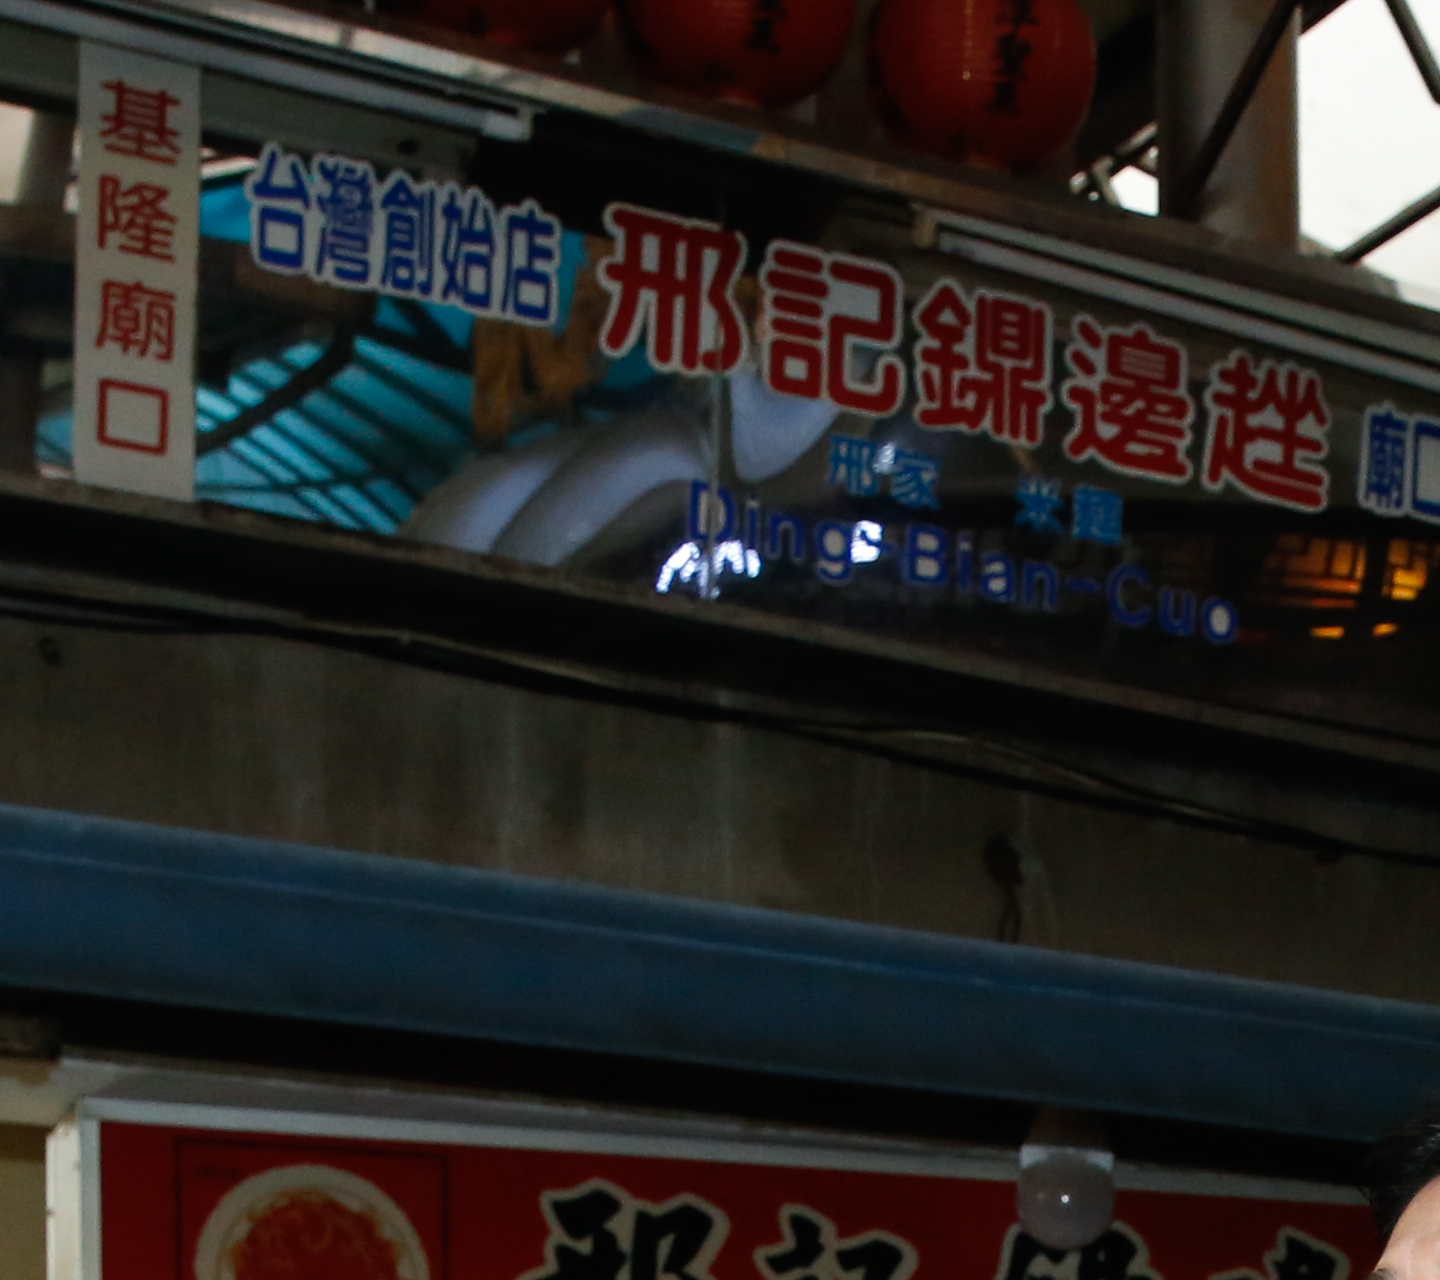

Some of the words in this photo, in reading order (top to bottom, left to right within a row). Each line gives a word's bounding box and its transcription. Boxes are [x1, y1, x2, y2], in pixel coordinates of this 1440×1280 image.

[94, 77, 181, 457] 基隆廟口
[250, 148, 557, 321] 台灣創始店
